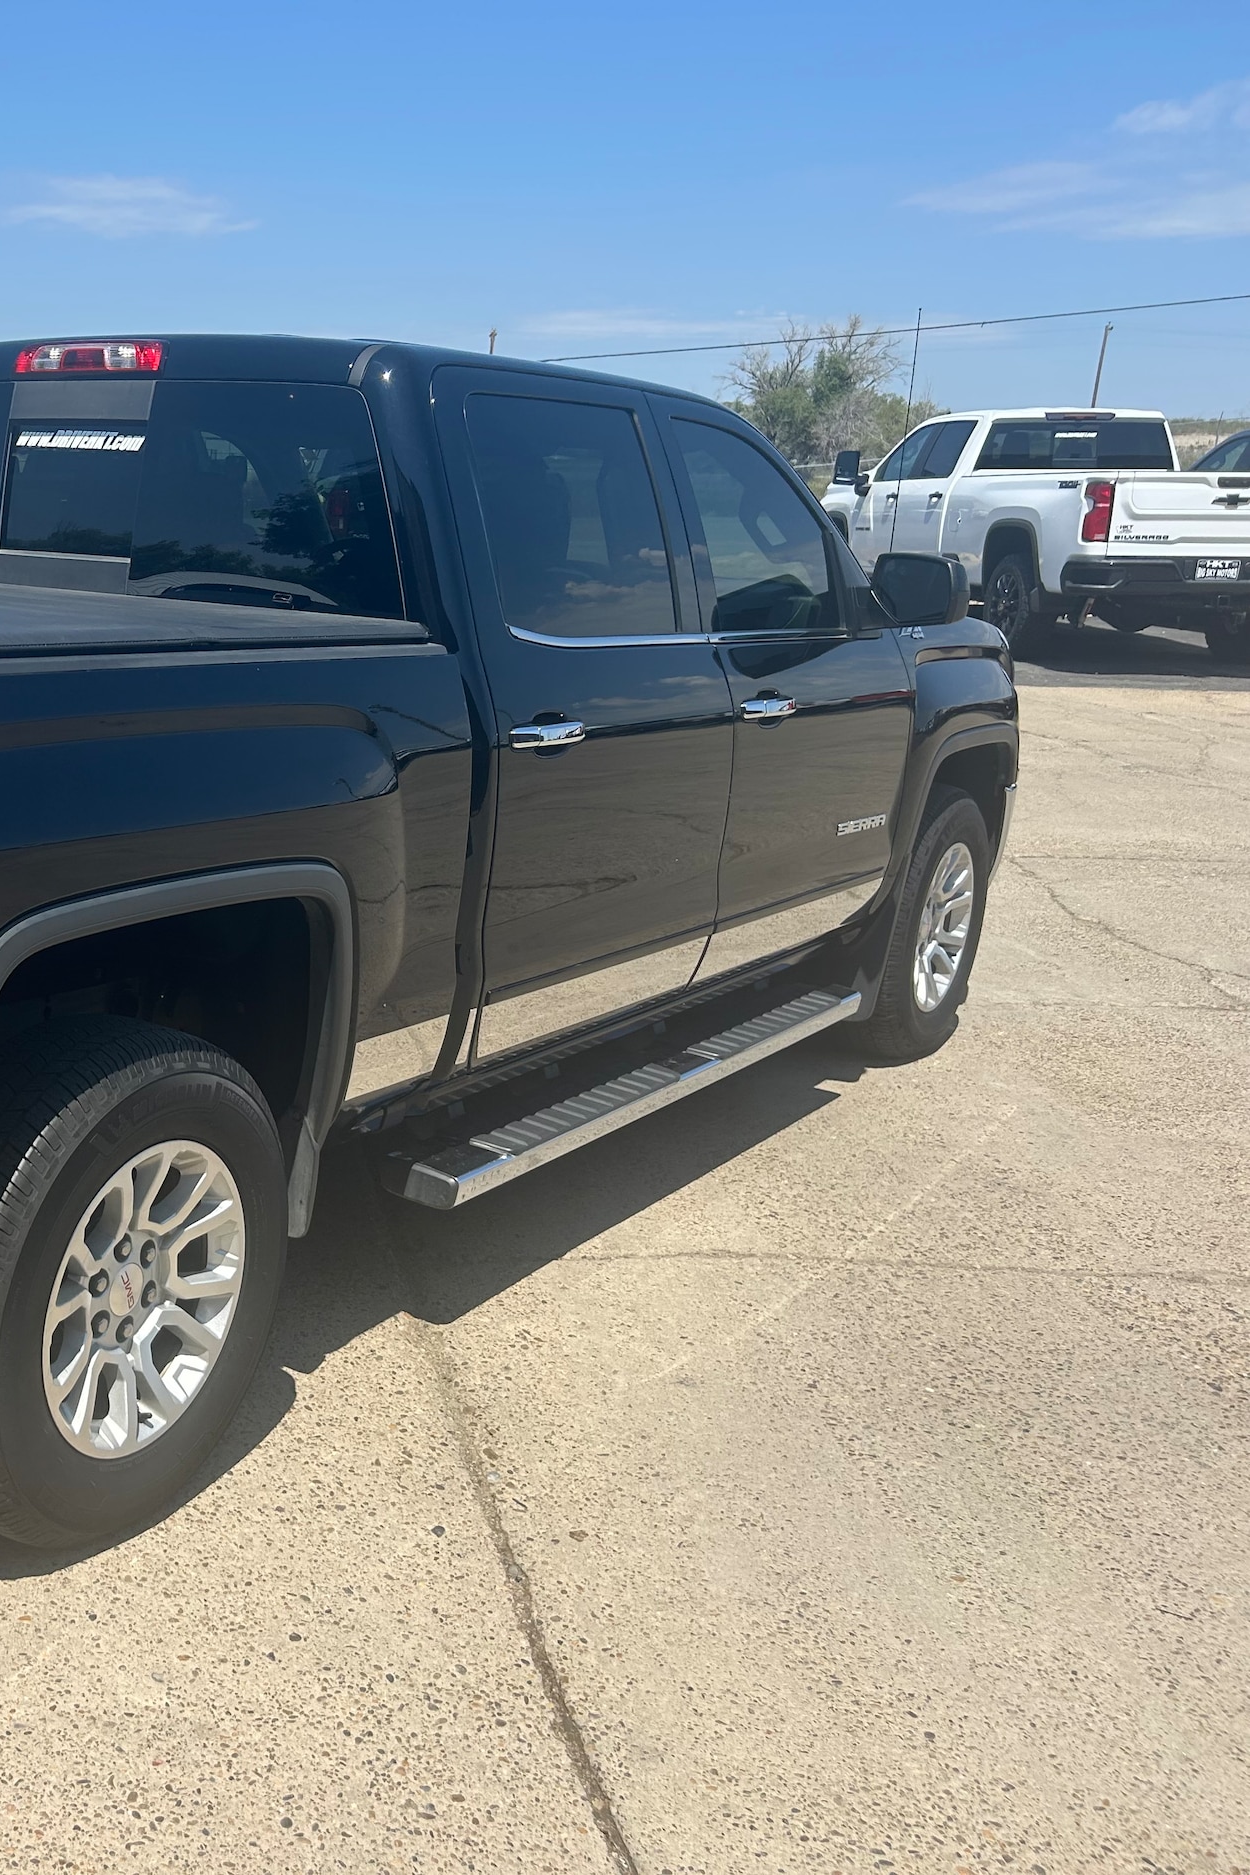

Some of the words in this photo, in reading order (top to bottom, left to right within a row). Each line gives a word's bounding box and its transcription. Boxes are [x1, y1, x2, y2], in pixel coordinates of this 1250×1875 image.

[1206, 560, 1233, 568] HKT
[836, 814, 887, 837] SIERRA
[121, 1271, 135, 1309] GMC
